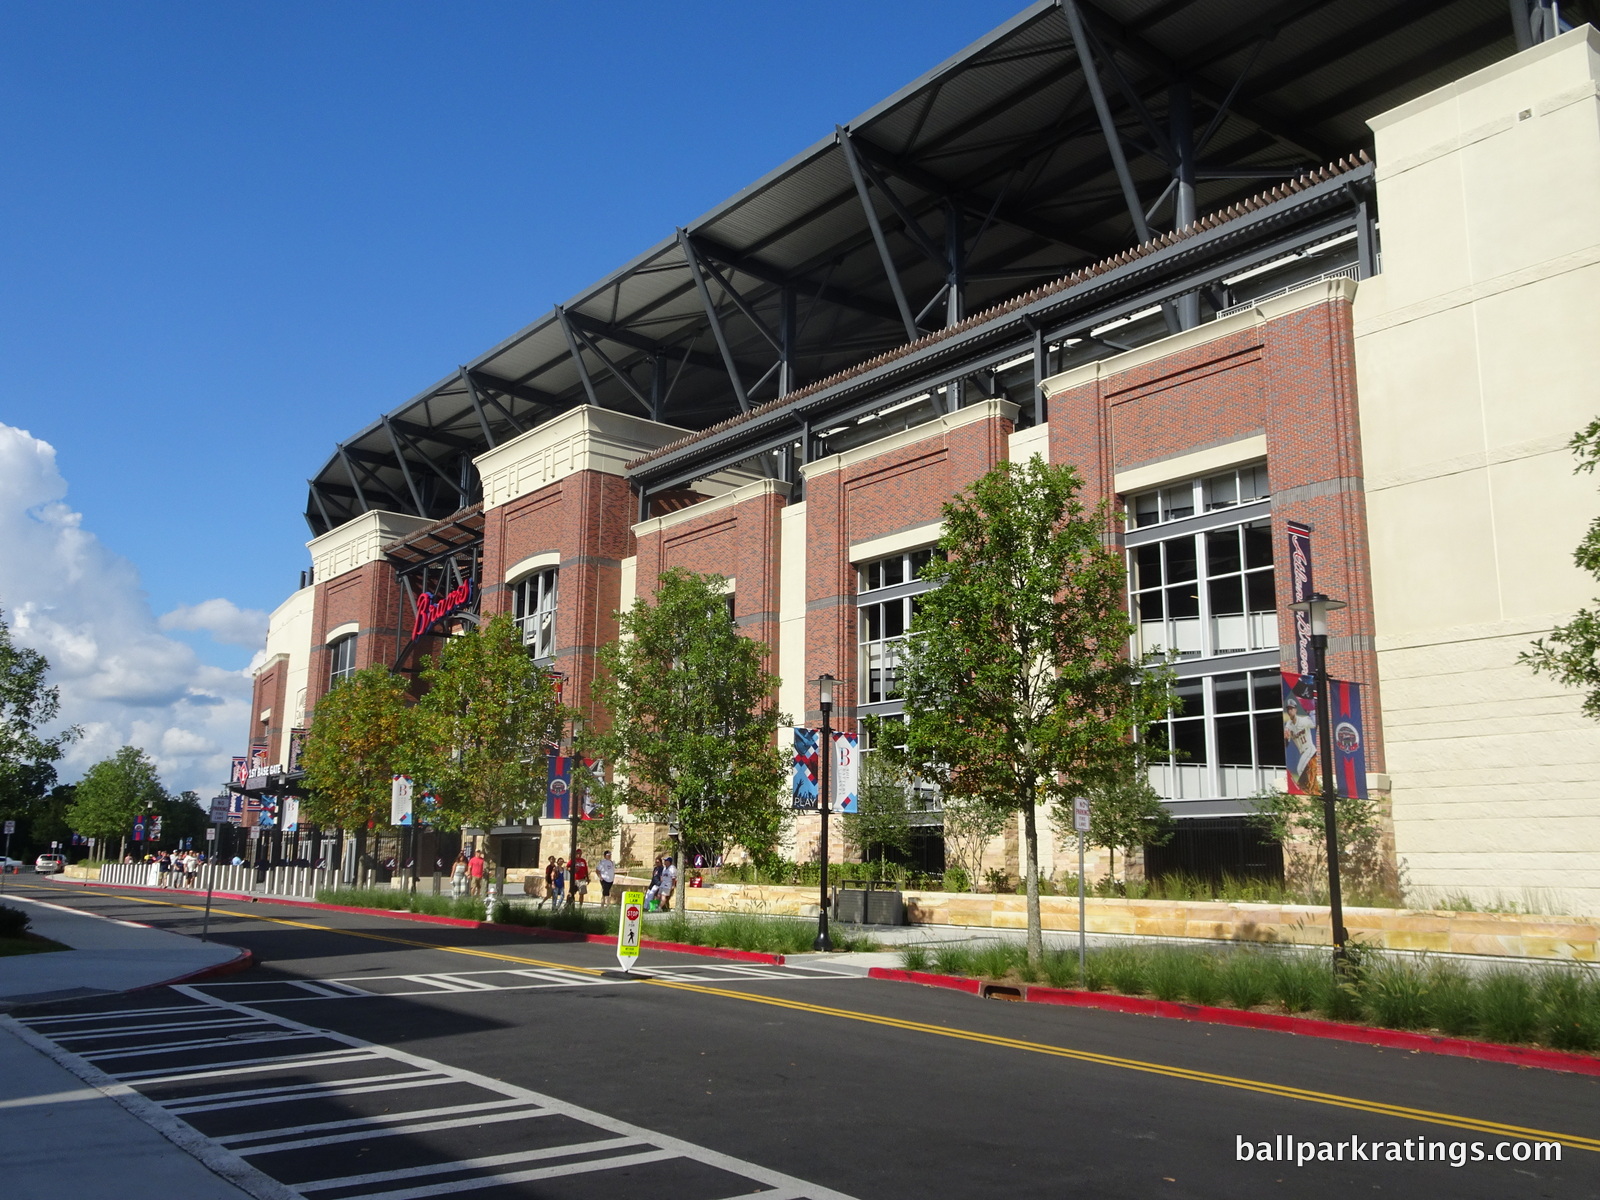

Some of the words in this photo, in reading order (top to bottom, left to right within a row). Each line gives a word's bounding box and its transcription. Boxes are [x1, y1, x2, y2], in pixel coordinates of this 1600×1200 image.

[411, 578, 471, 641] Braves
[839, 748, 851, 766] B
[257, 766, 270, 777] BASE
[269, 764, 282, 775] GATE
[794, 797, 817, 807] PLAY
